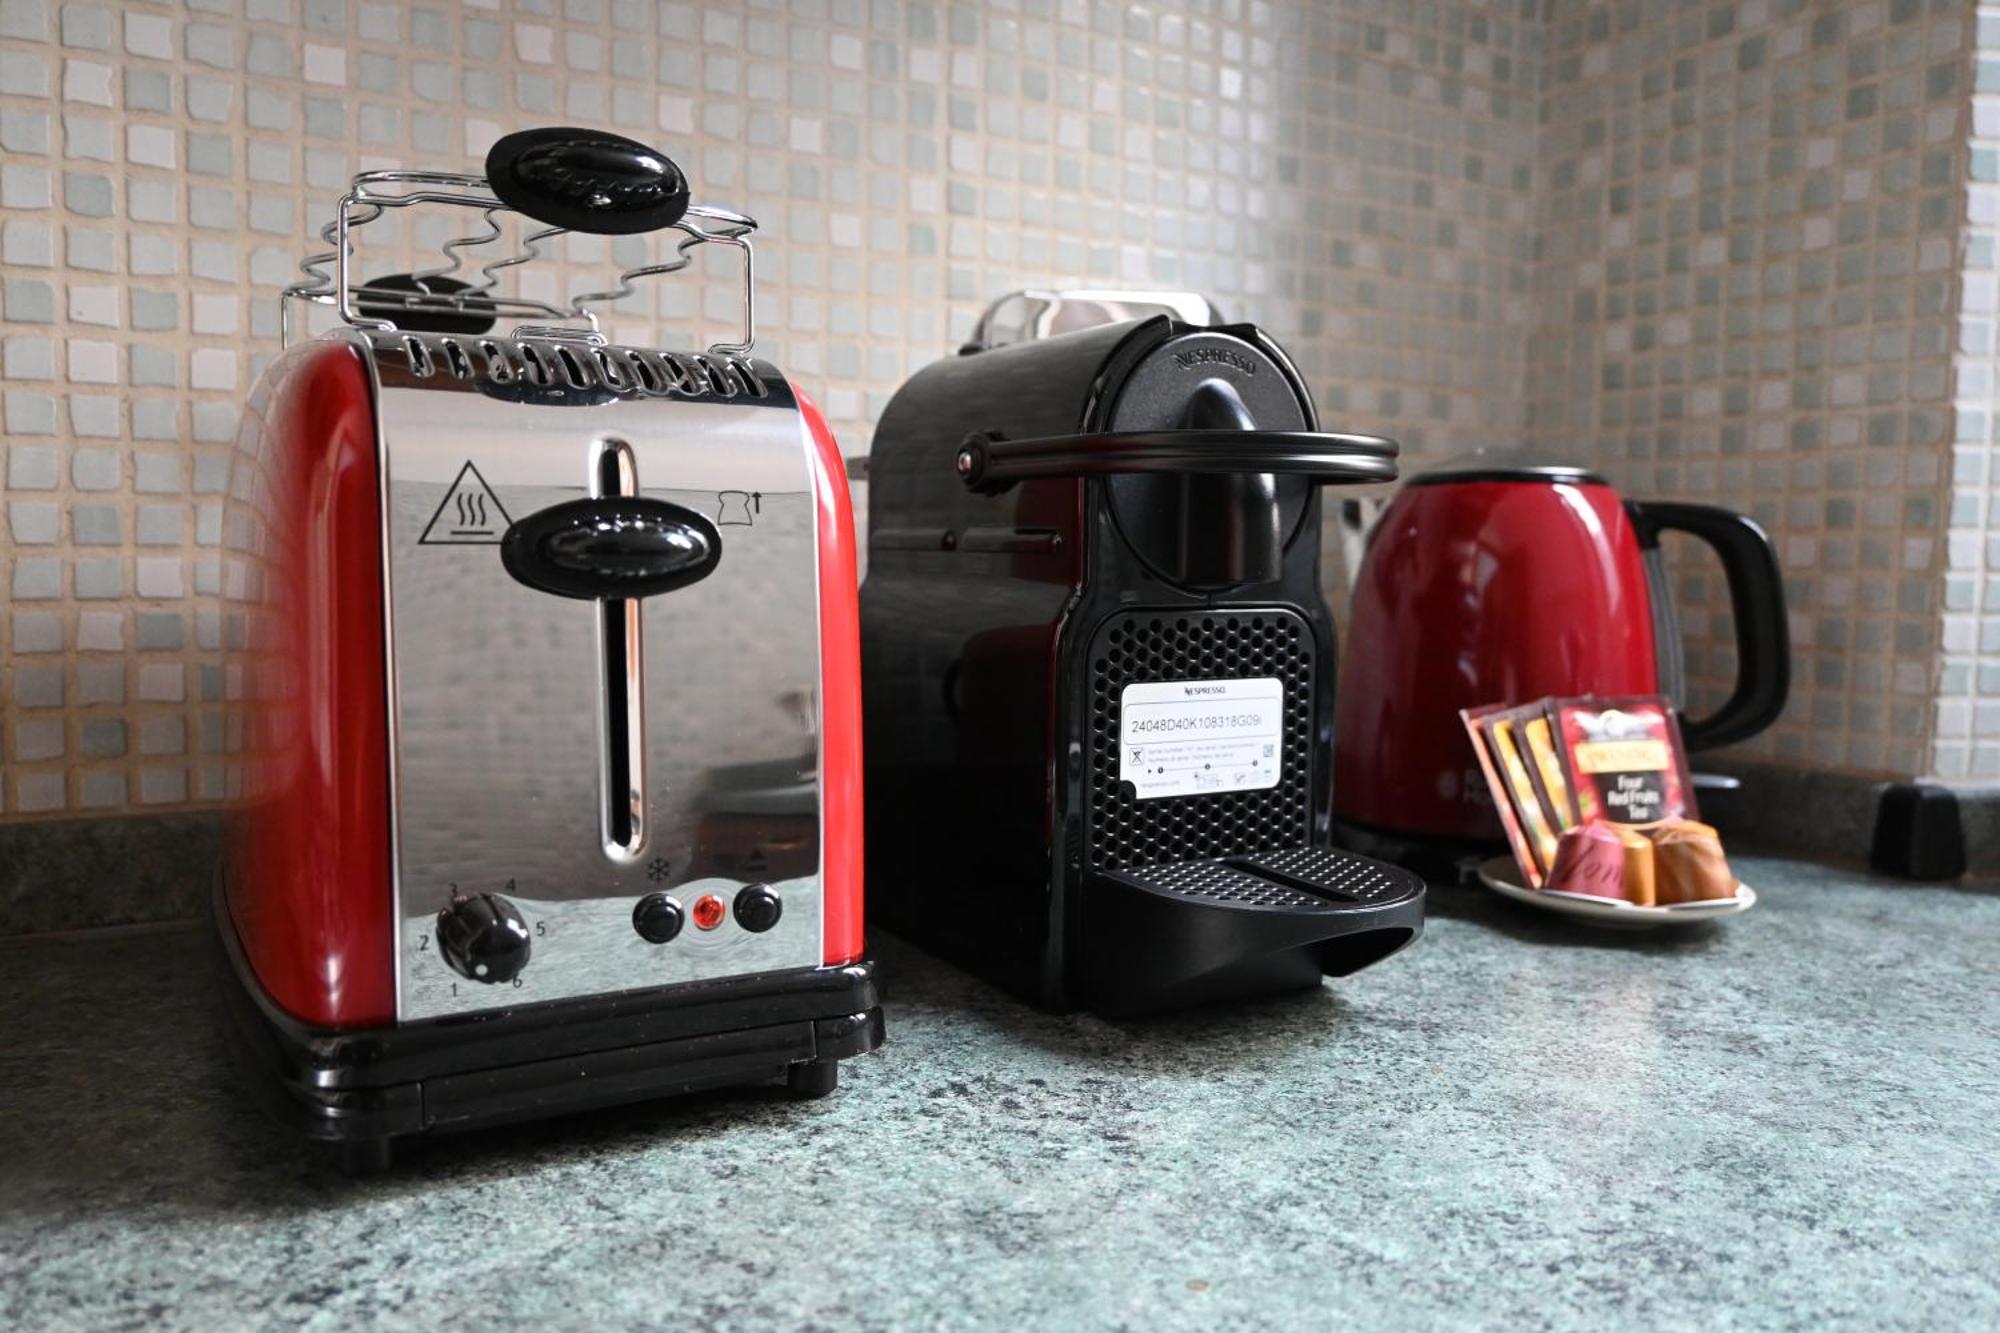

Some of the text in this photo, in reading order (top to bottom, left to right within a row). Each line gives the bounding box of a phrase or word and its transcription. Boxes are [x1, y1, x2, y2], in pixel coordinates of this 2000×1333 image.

[1171, 349, 1256, 377] NESPRESSO
[1184, 686, 1227, 697] NESPRESSO
[1617, 774, 1643, 791] Four
[449, 882, 458, 896] 3
[506, 878, 516, 892] 4
[536, 921, 546, 936] 5
[419, 935, 430, 951] 2
[512, 972, 523, 988] 6
[450, 982, 457, 997] 1
